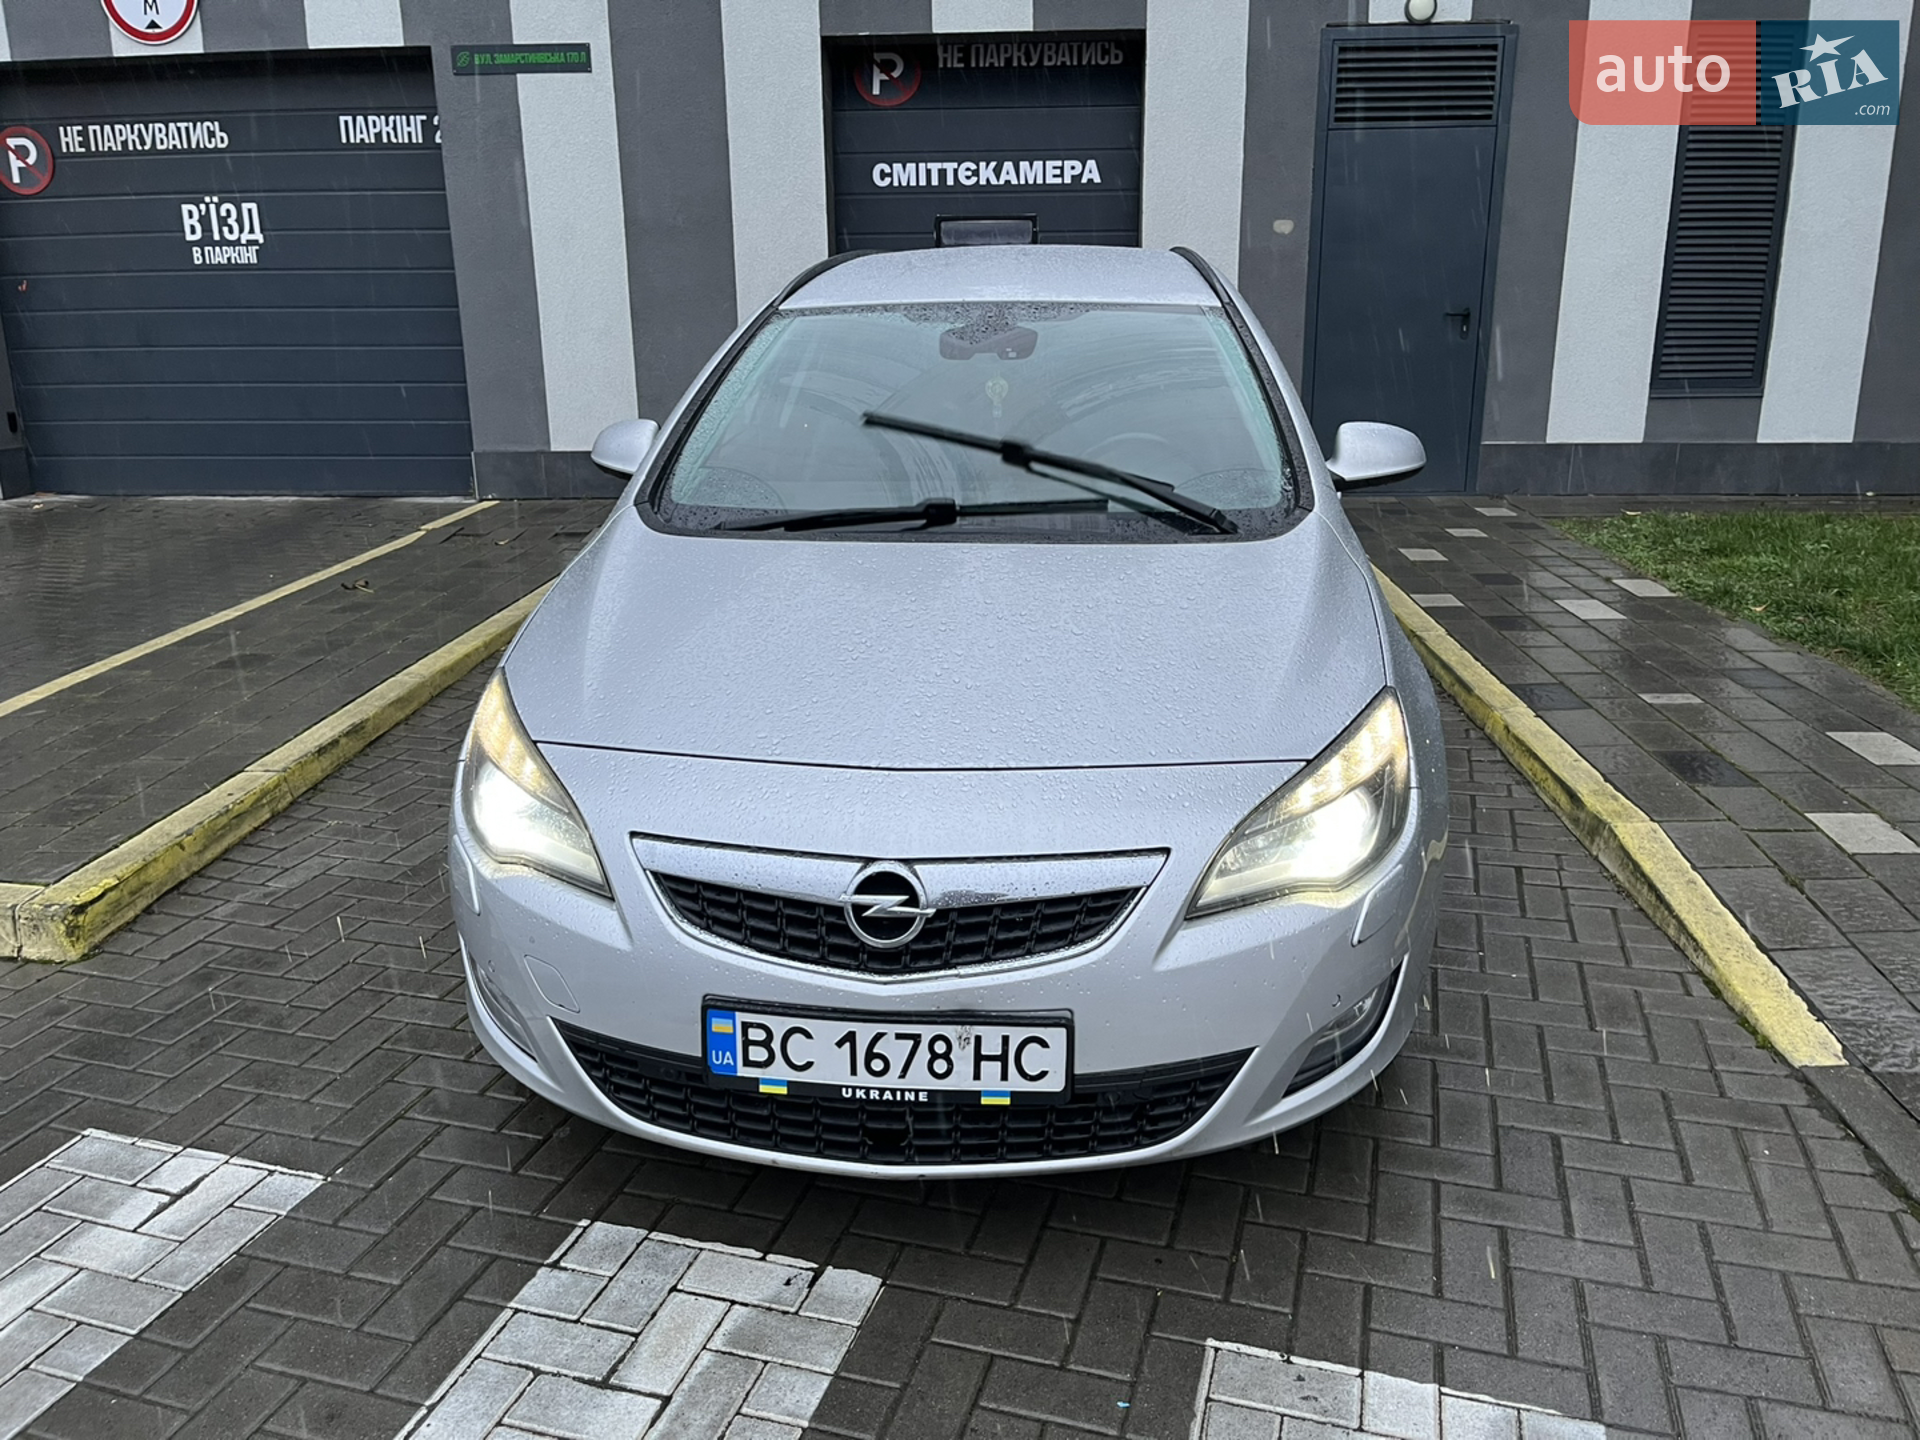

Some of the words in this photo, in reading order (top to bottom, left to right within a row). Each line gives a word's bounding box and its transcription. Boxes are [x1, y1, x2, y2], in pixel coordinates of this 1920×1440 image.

[938, 44, 964, 68] НЕ
[970, 41, 1124, 68] ПАРКУВАТИСЬ
[59, 125, 86, 152] НЕ
[87, 121, 229, 152] ПАРКУВАТИСЬ
[339, 115, 427, 143] ПАРКІНГ
[872, 159, 1101, 187] СМІТТЄКАМЕРА
[181, 196, 264, 244] В'ЇЗД
[192, 246, 203, 264] В
[204, 246, 259, 264] ПАРКІНГ
[712, 1050, 734, 1066] UA
[741, 1020, 815, 1072] BC
[834, 1030, 954, 1080] 1678
[972, 1034, 1050, 1082] HC
[841, 1087, 929, 1102] UKRAINE
